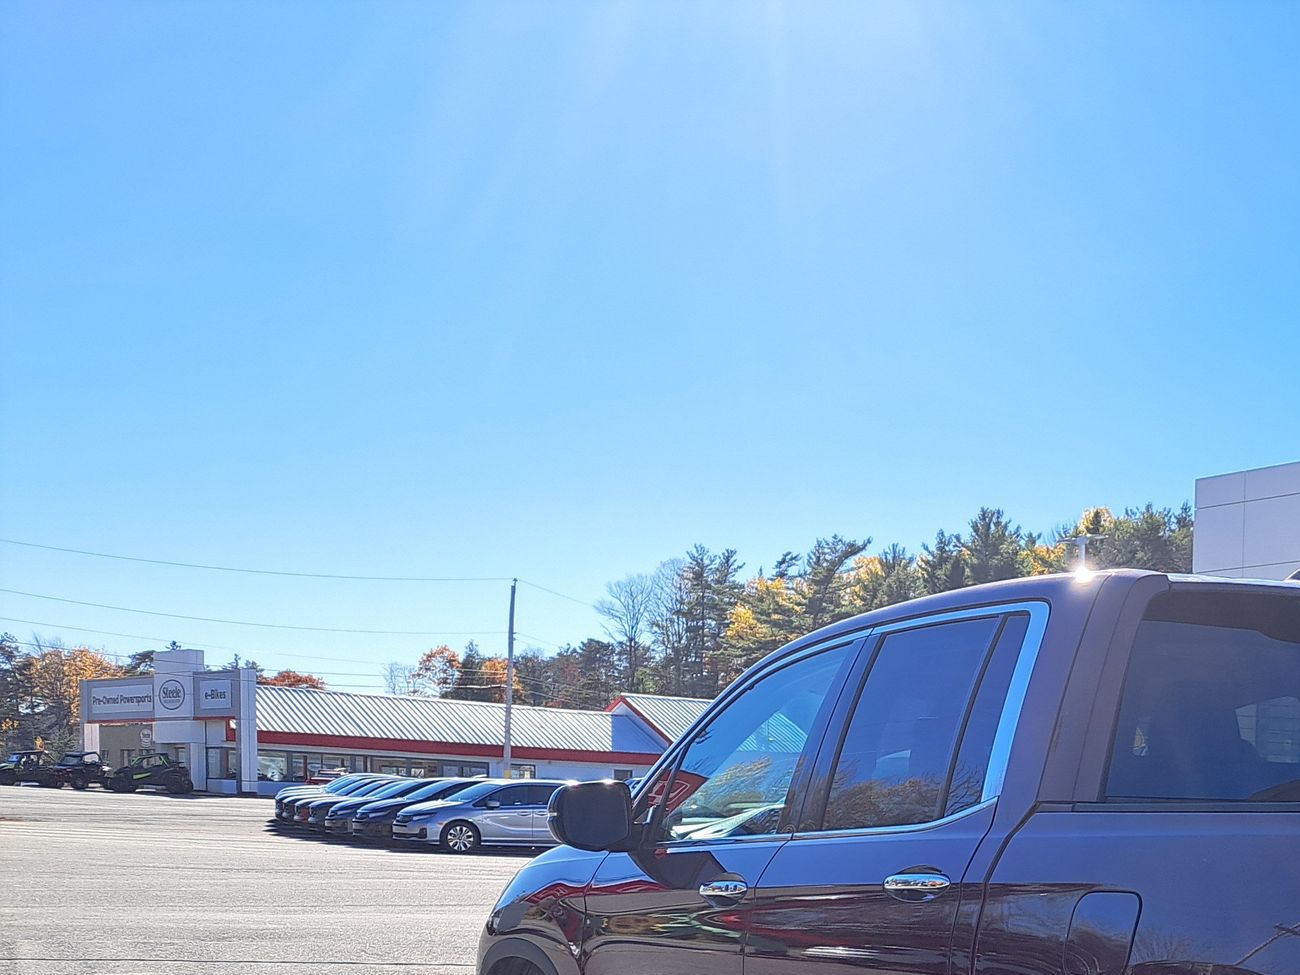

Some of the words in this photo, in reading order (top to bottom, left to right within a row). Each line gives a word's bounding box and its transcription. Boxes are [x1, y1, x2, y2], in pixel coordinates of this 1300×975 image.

[161, 686, 182, 699] Steele
[204, 689, 226, 700] e-Bikes
[92, 694, 119, 705] Pre-Owned
[119, 694, 152, 706] Powersports
